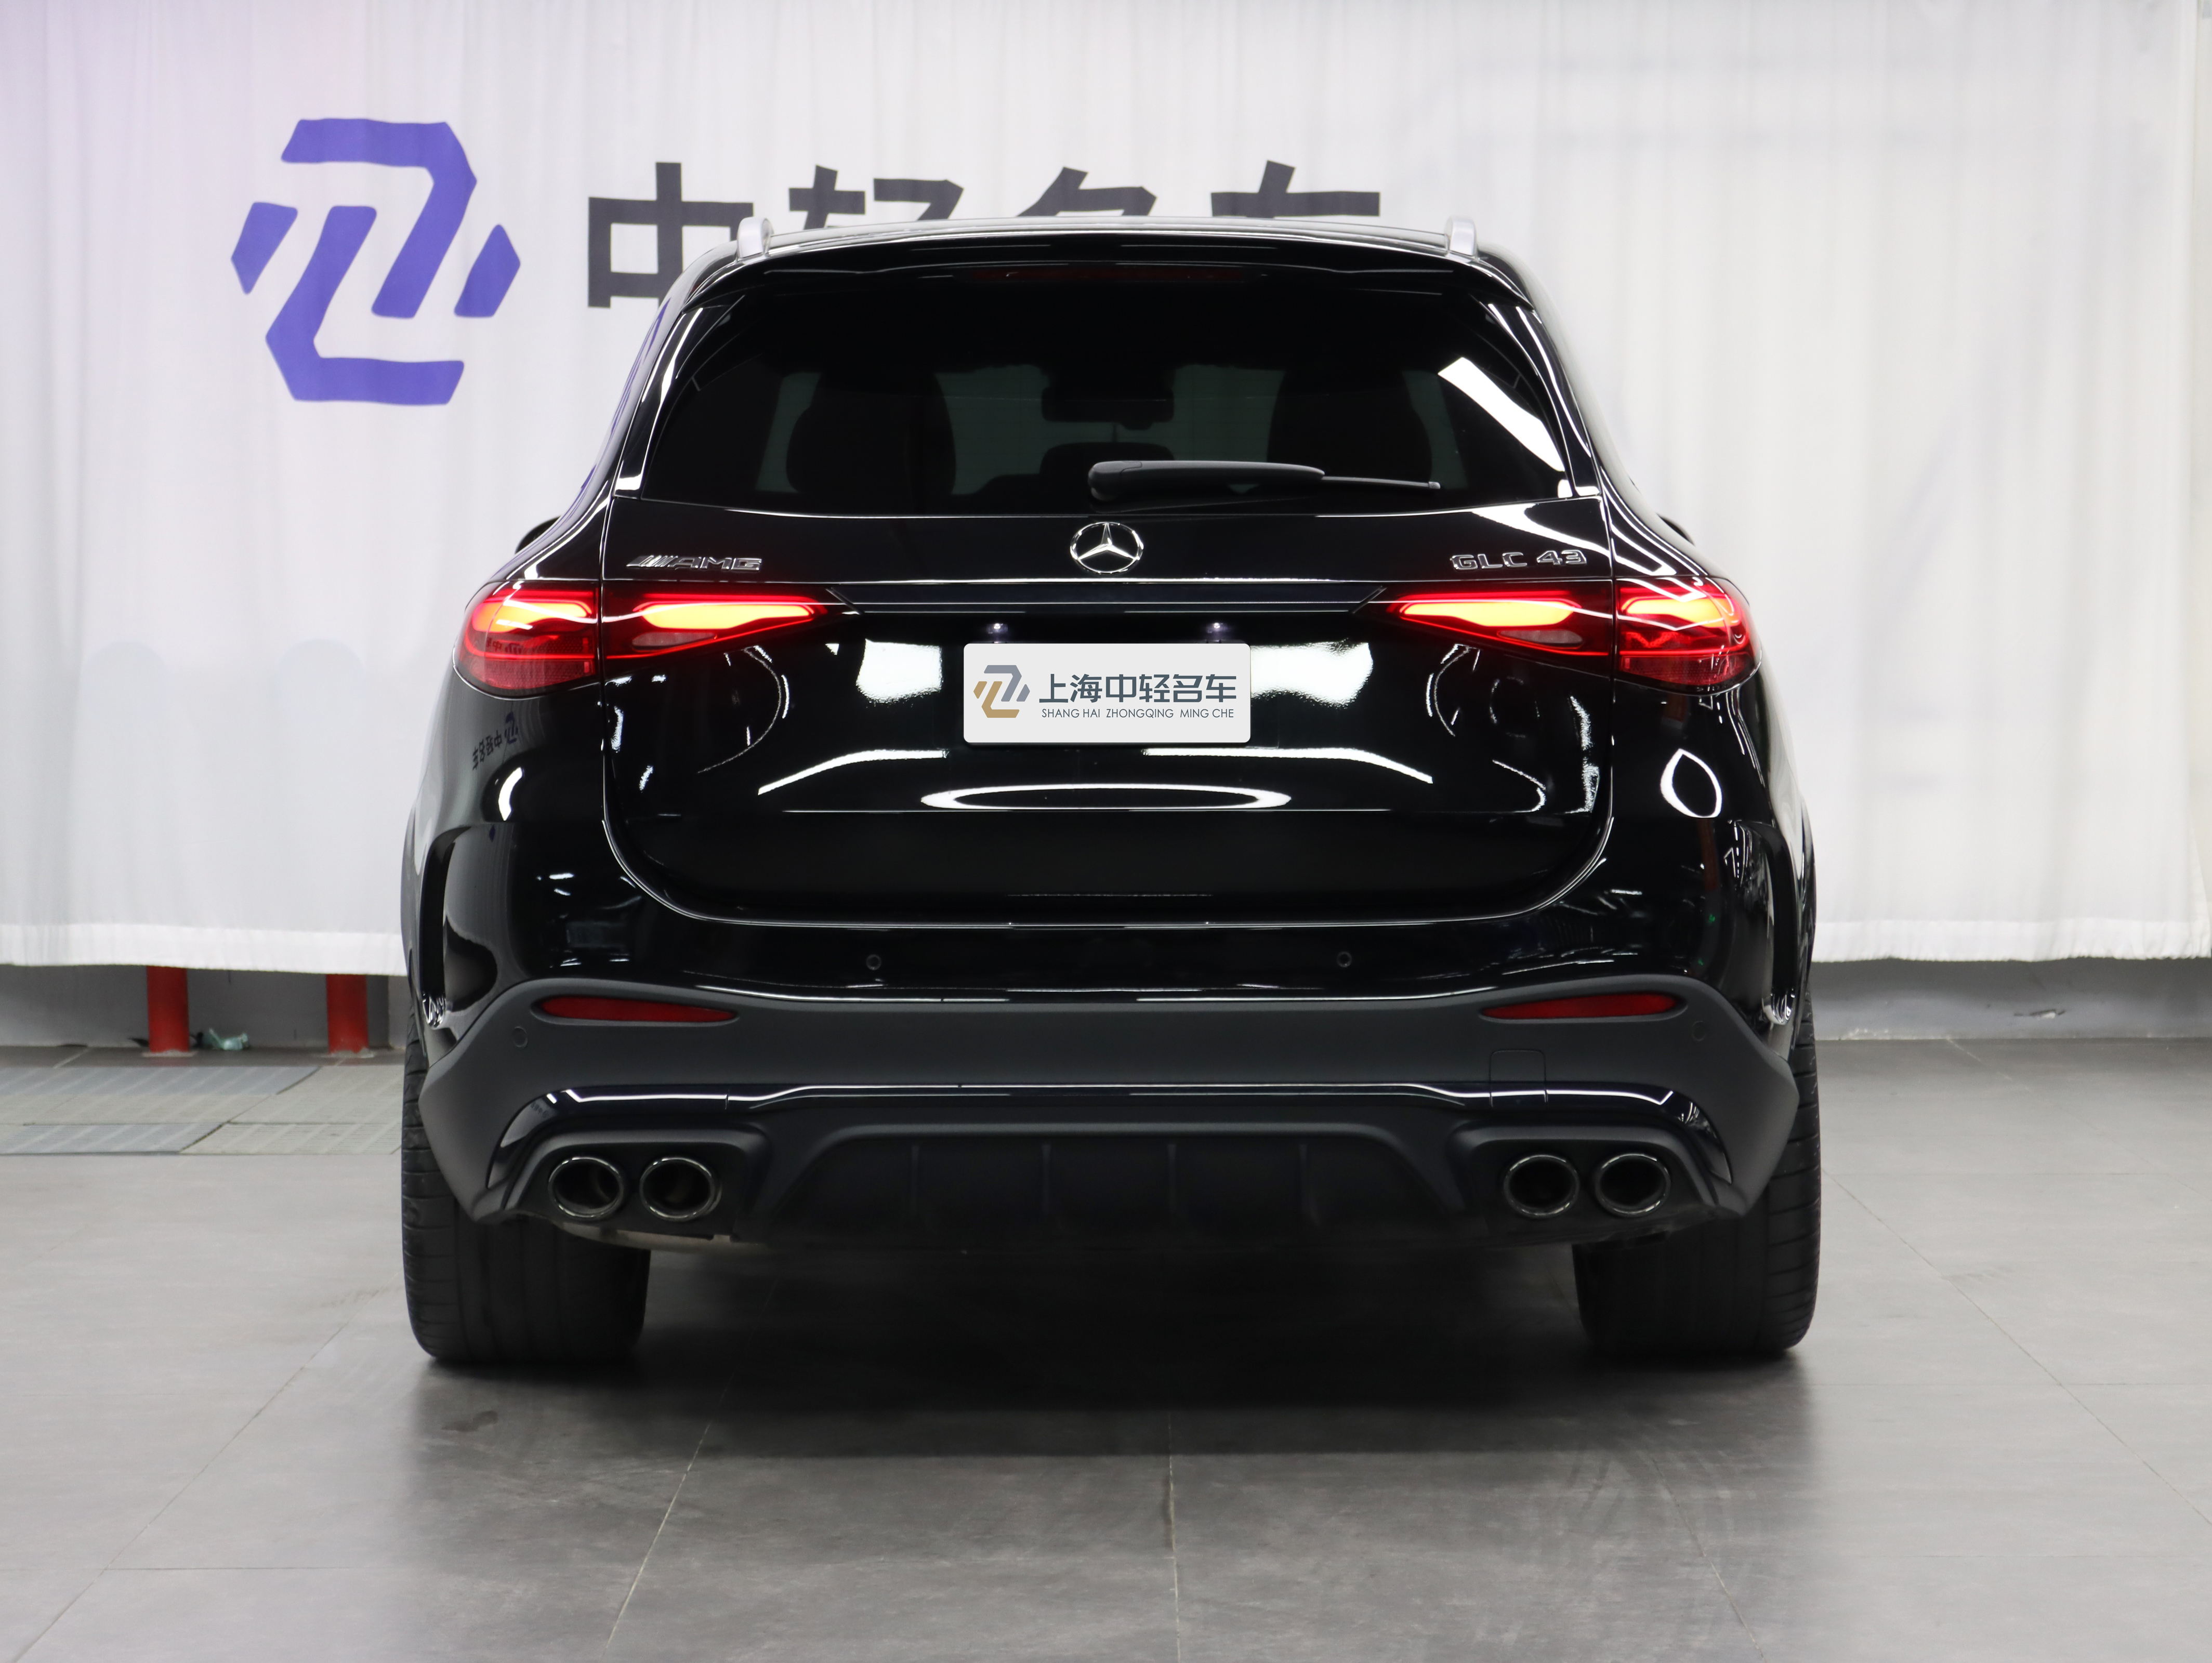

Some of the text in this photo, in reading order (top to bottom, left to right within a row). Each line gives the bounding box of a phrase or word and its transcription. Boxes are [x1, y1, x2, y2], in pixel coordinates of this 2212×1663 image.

[674, 556, 762, 571] AMG
[1450, 549, 1587, 571] GLC 43
[1039, 674, 1236, 703] 上海中轻名车
[1042, 708, 1234, 719] SHANG HAI ZHONGQING MING CHE
